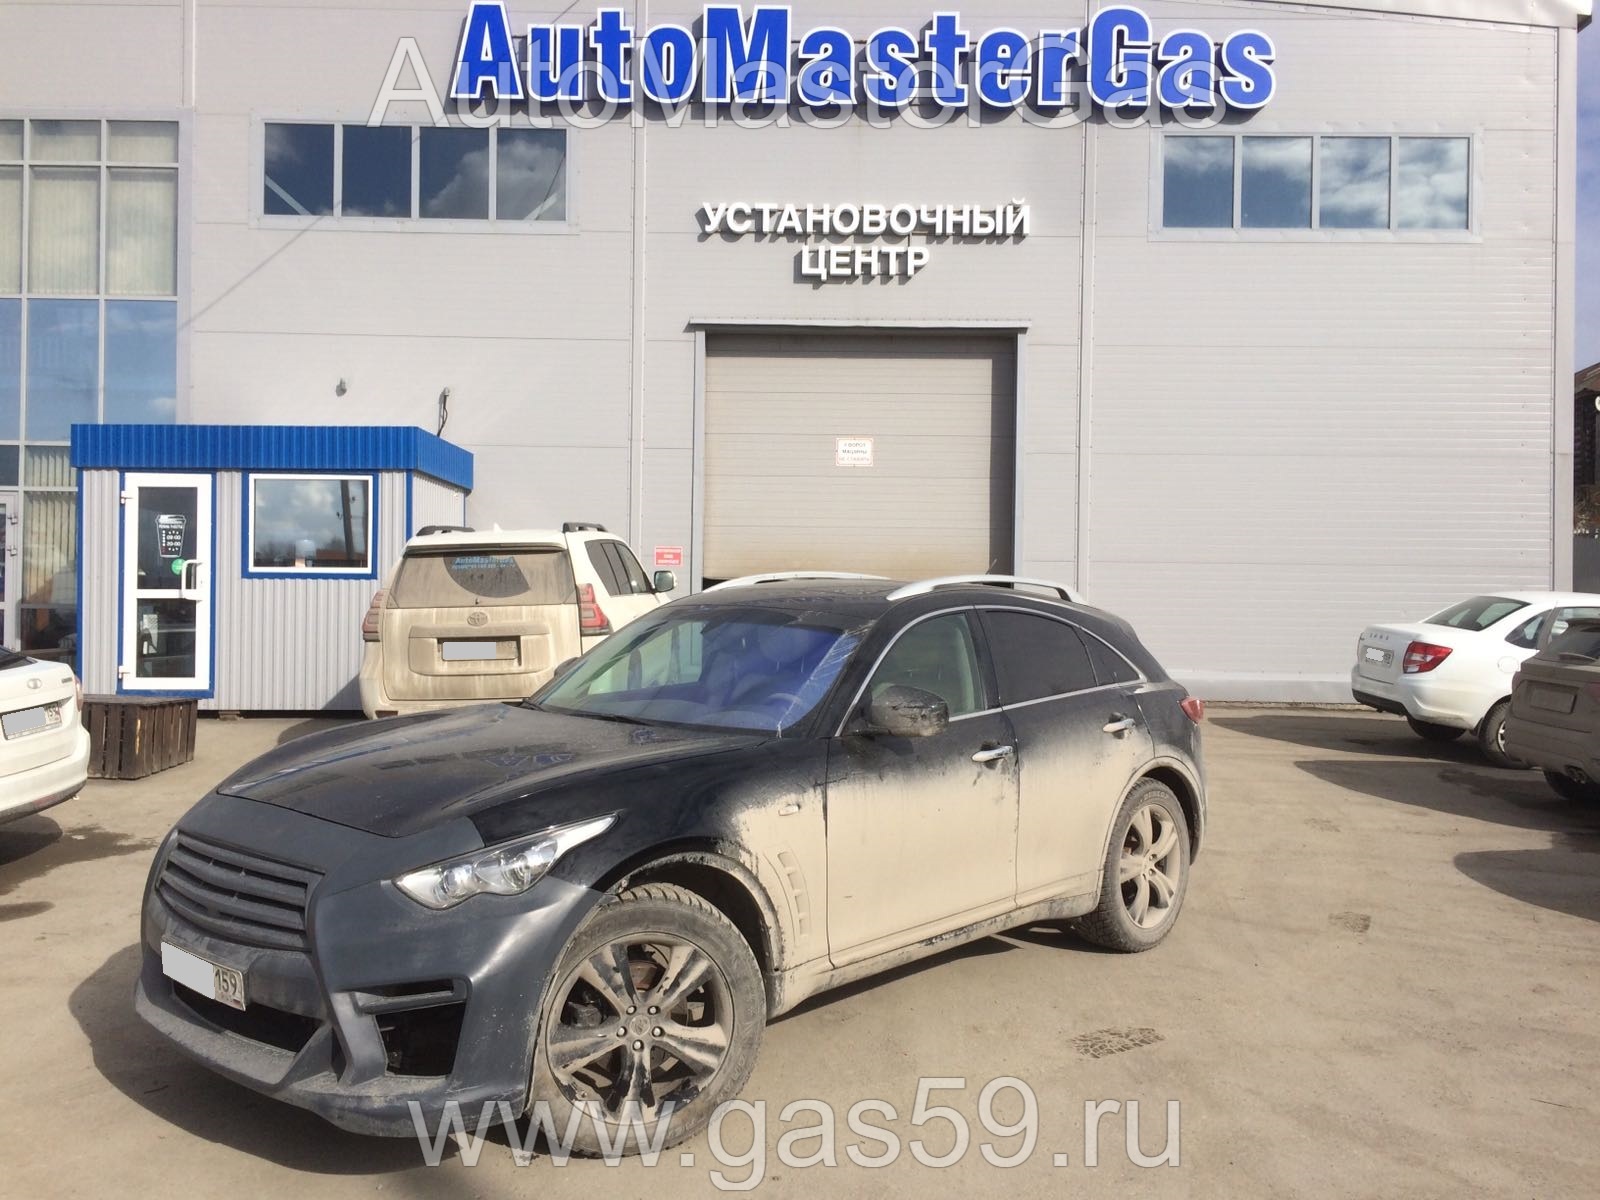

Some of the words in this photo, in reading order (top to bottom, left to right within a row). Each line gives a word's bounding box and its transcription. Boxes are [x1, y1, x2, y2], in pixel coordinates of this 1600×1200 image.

[450, 0, 1276, 108] AutoMasterGas
[701, 197, 1031, 236] УСТАНОВОЧНЫЙ
[801, 245, 930, 281] ЦЕНТР
[215, 969, 237, 995] 159
